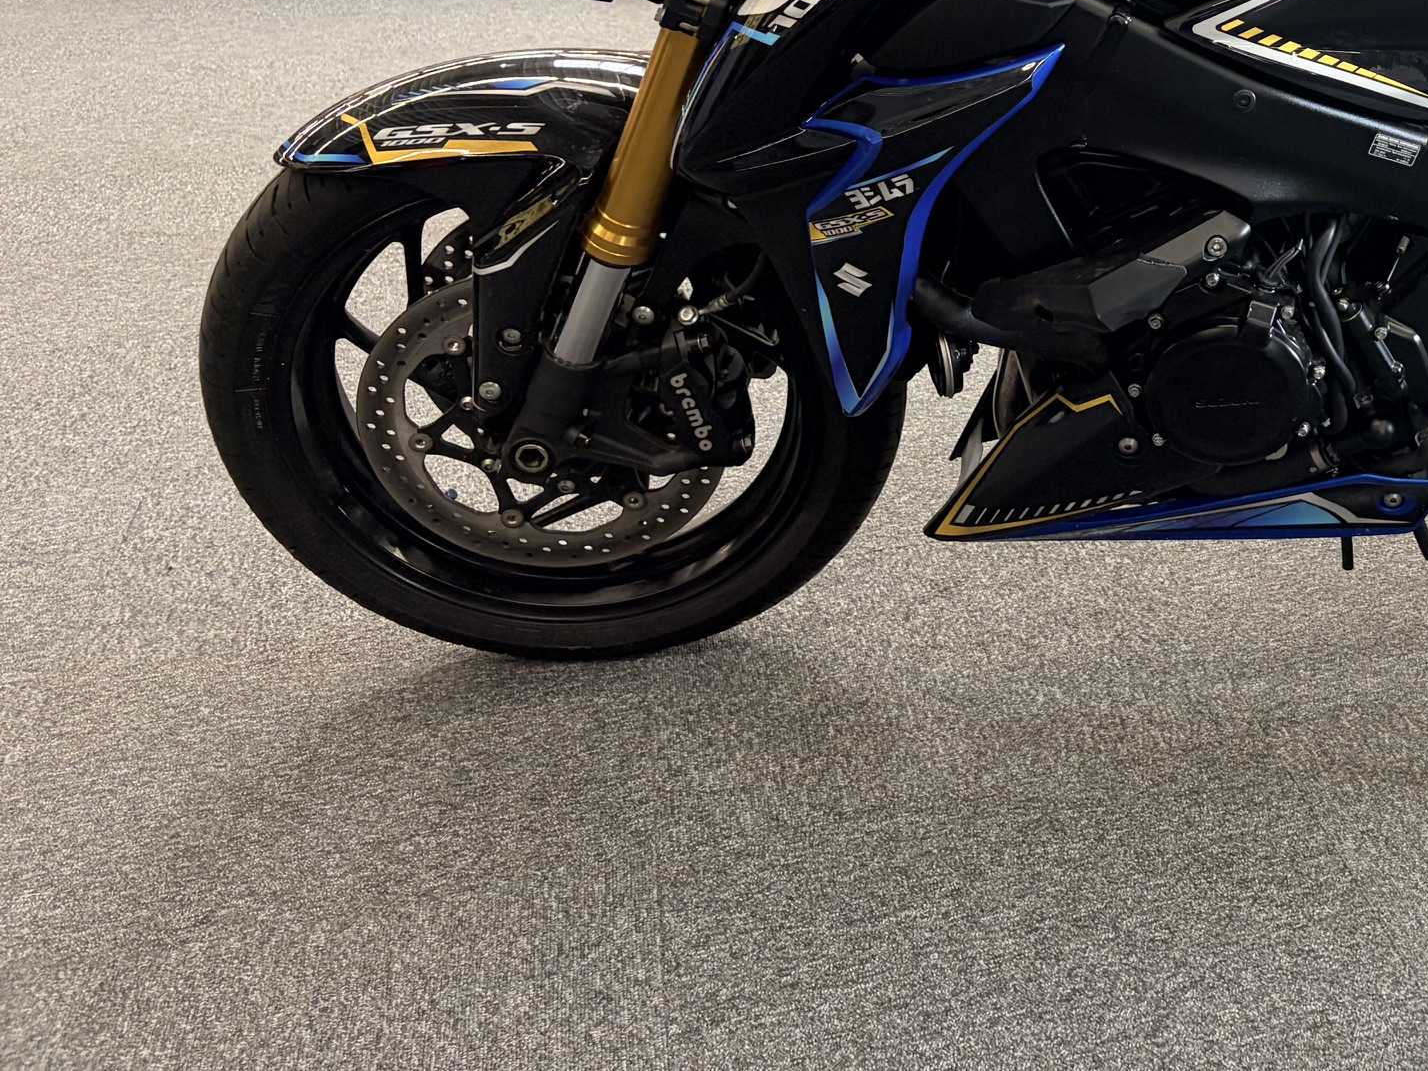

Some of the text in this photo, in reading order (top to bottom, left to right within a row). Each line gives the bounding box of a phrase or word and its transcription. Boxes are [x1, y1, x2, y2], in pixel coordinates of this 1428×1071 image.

[380, 136, 446, 148] 1000
[822, 225, 854, 237] 1000
[670, 373, 713, 451] brembo
